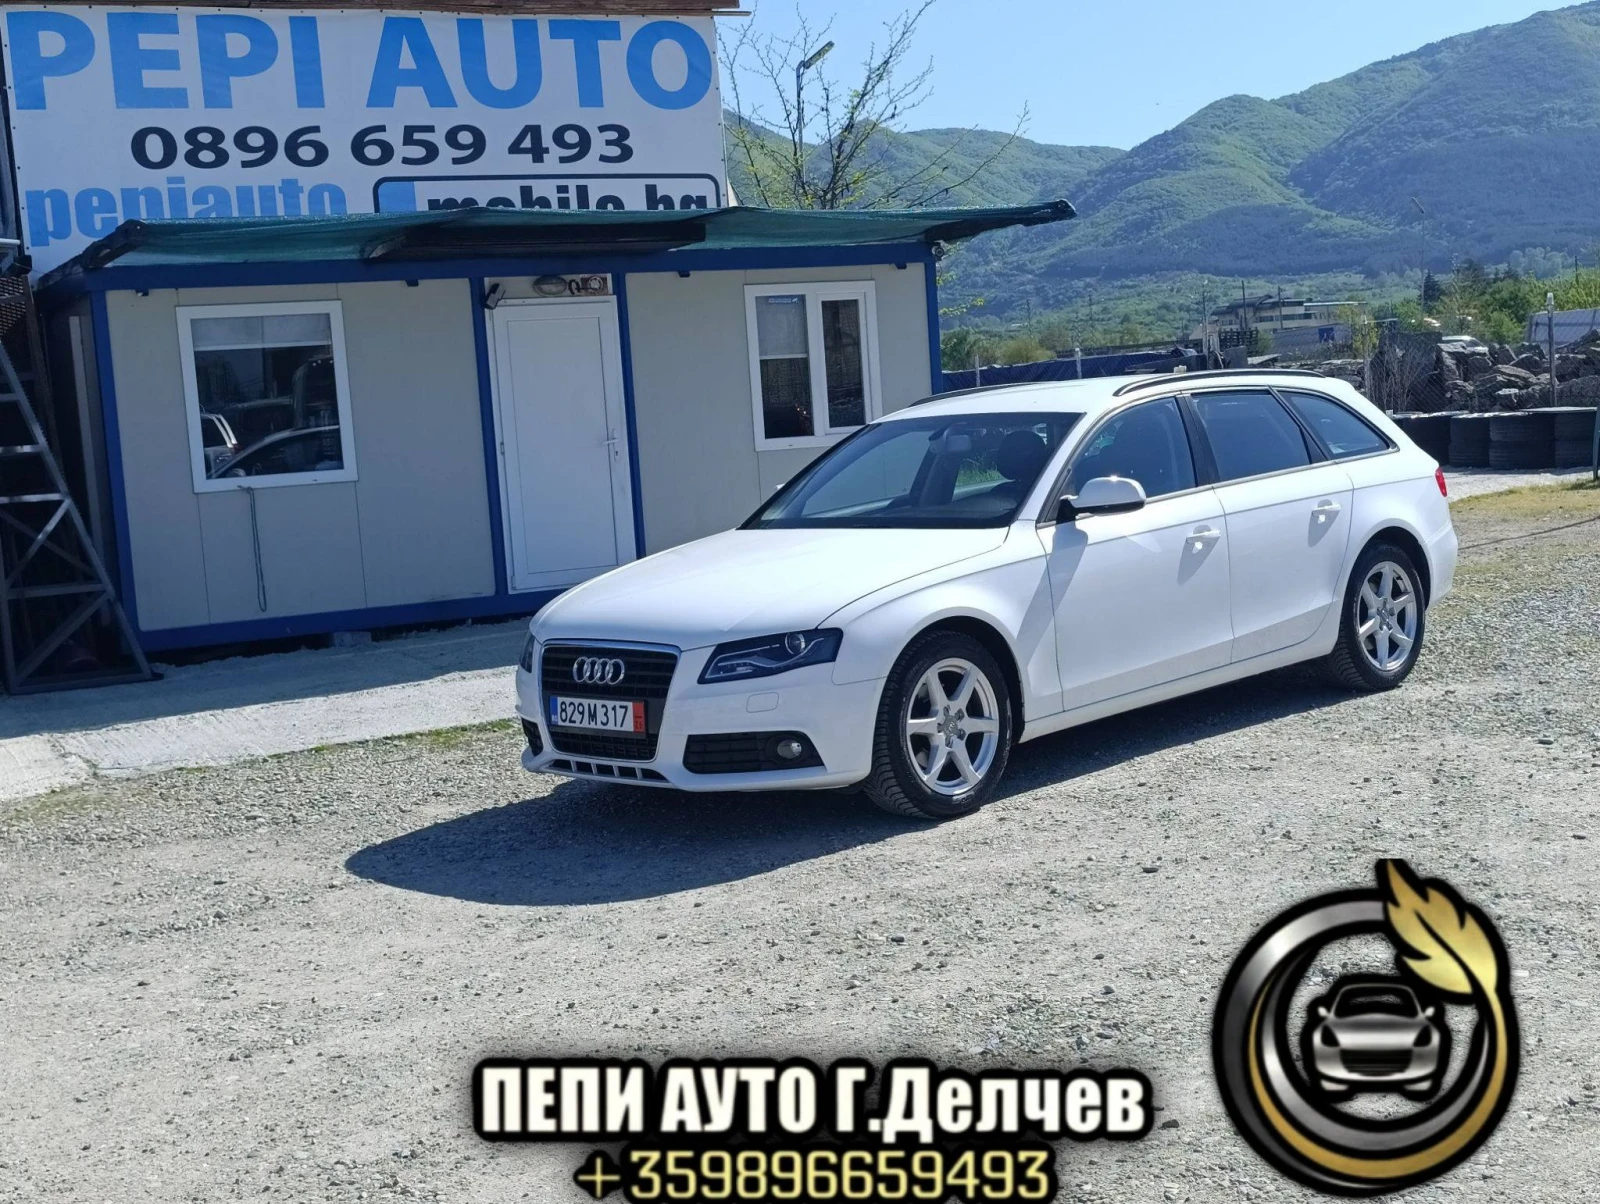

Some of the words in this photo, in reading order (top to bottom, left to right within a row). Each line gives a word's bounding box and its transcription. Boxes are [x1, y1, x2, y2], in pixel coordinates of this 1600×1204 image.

[5, 11, 325, 111] PEPI
[365, 17, 713, 111] AUTO
[130, 126, 329, 170] 0896
[350, 125, 486, 167] 659
[508, 124, 633, 164] 493
[559, 700, 629, 728] 829M317
